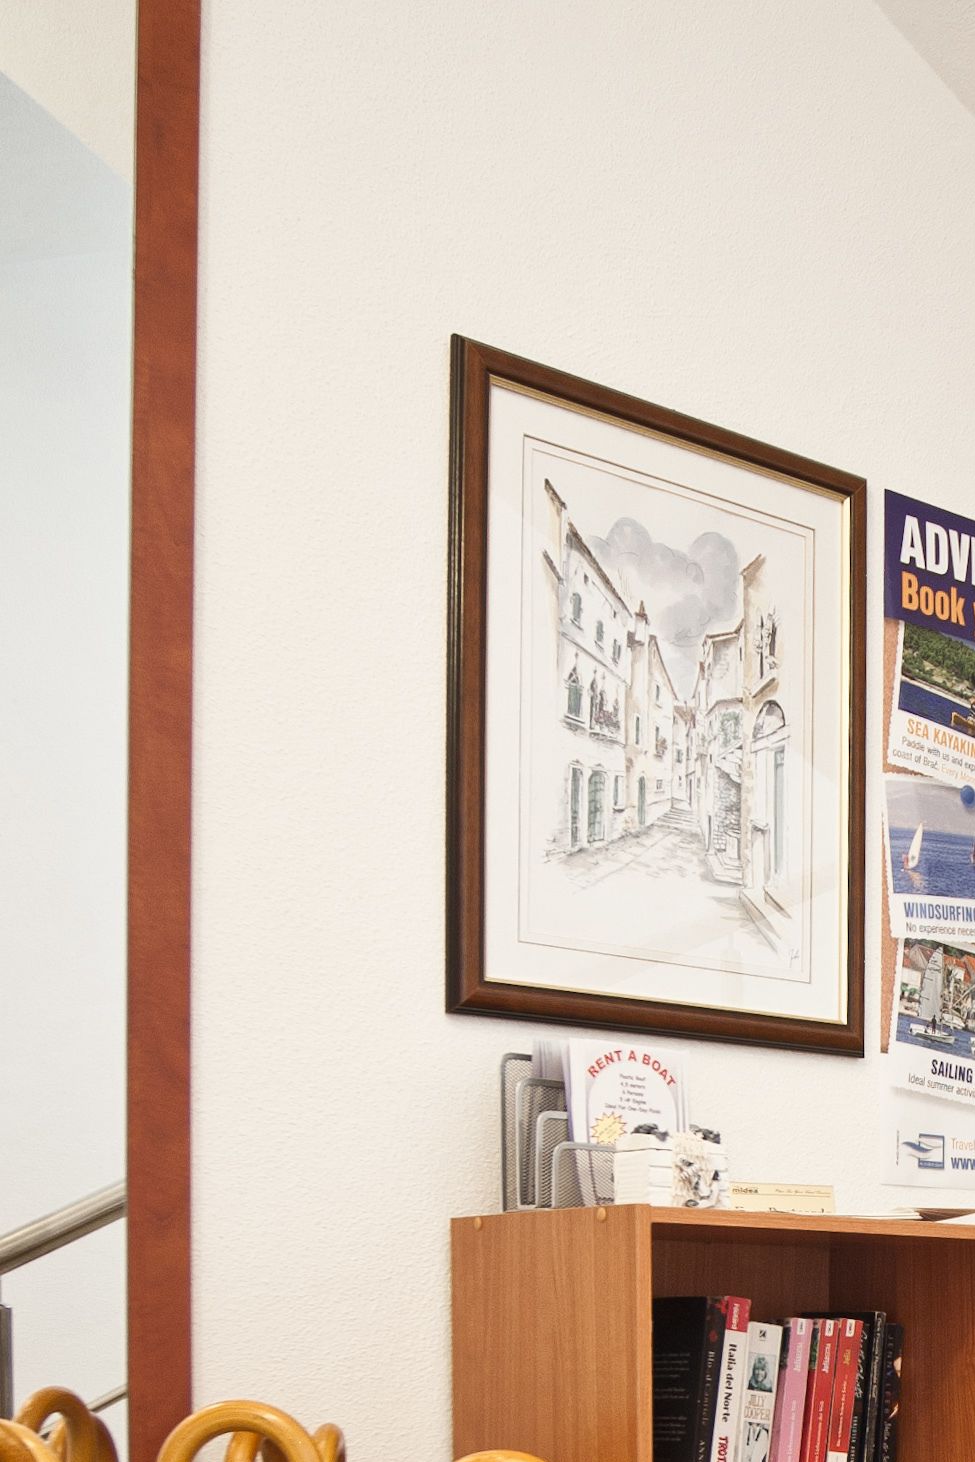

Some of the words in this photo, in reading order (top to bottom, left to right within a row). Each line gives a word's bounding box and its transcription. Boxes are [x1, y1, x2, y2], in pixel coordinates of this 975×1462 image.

[901, 570, 966, 626] Book
[907, 718, 929, 740] SEA
[892, 749, 913, 761] coast
[915, 754, 921, 763] of
[927, 744, 940, 758] with
[943, 751, 950, 761] us
[952, 755, 963, 767] and
[906, 922, 917, 932] No
[919, 924, 956, 937] experience
[587, 1050, 622, 1078] RENT
[628, 1050, 637, 1062] A
[642, 1054, 676, 1086] BOAT
[931, 1059, 973, 1083] SAILING
[908, 1073, 925, 1085] Ideal
[927, 1079, 954, 1092] summer
[950, 1137, 975, 1151] Travel
[727, 1343, 738, 1370] Italia
[724, 1372, 734, 1391] del
[722, 1392, 733, 1423] Norte
